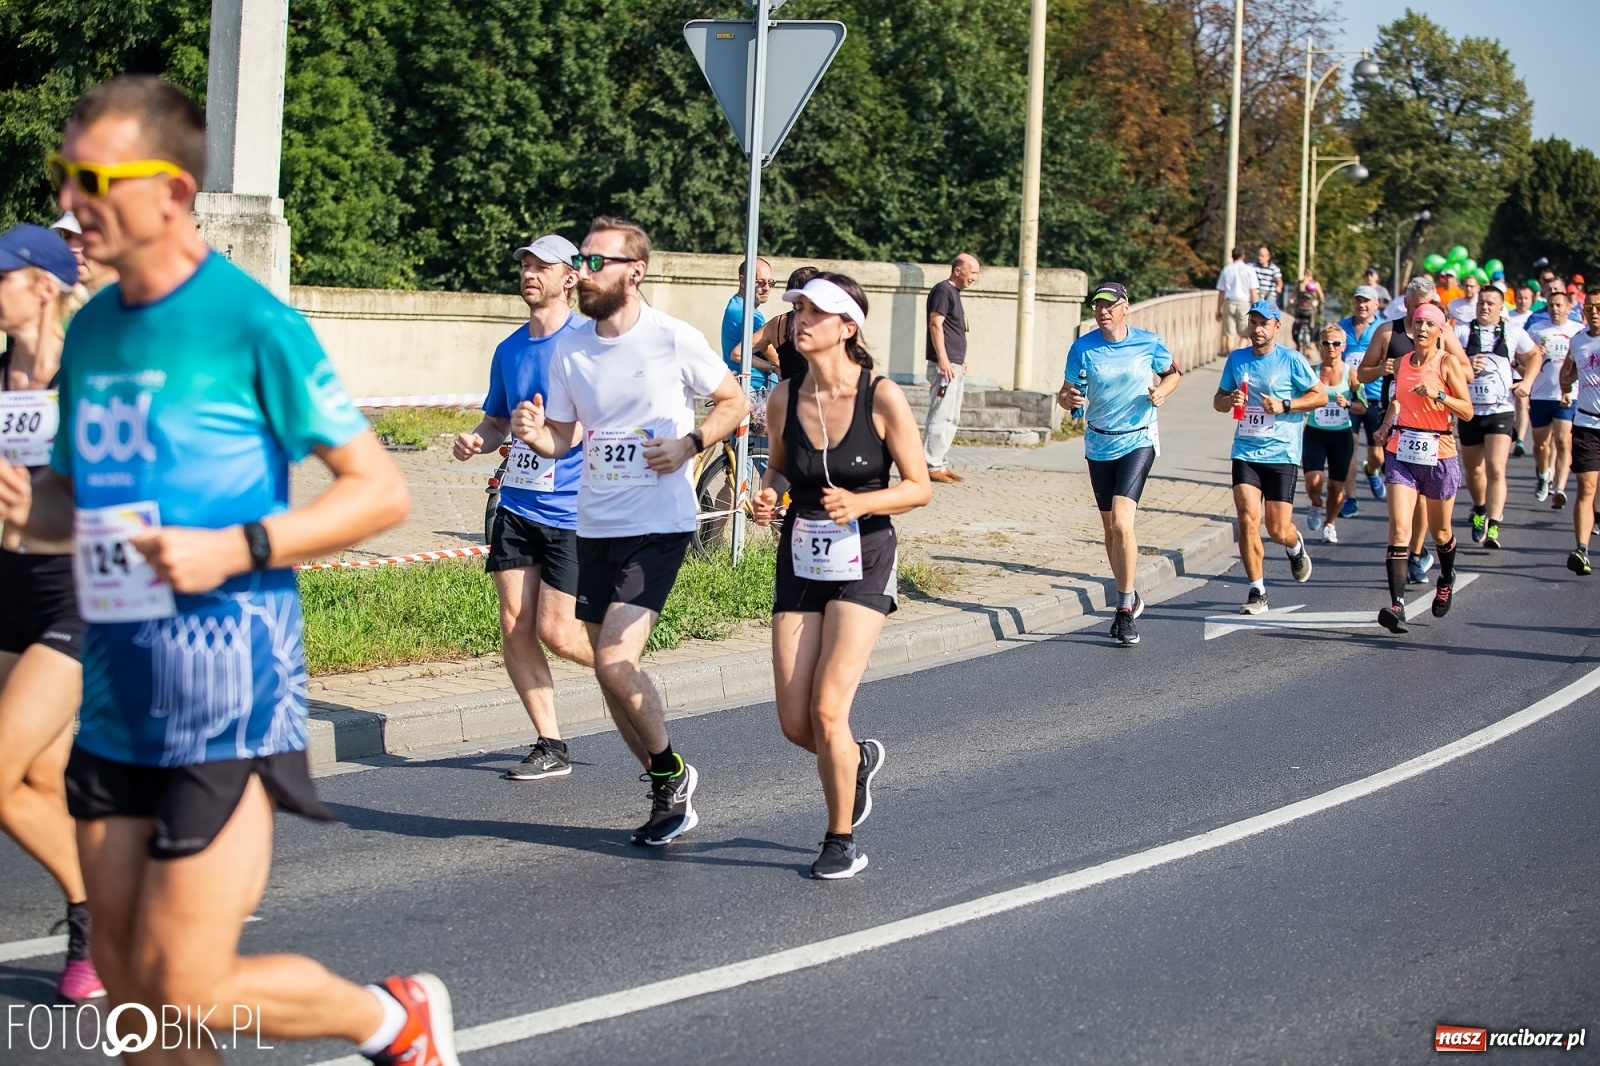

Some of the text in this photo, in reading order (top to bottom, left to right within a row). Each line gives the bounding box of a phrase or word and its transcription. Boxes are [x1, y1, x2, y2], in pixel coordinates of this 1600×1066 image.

[1474, 386, 1489, 394] 116
[1249, 414, 1265, 425] 161
[1324, 409, 1340, 417] 388
[2, 412, 41, 433] 380
[604, 443, 637, 463] 327
[1408, 440, 1428, 452] 258
[517, 453, 539, 470] 256
[811, 537, 832, 556] 57
